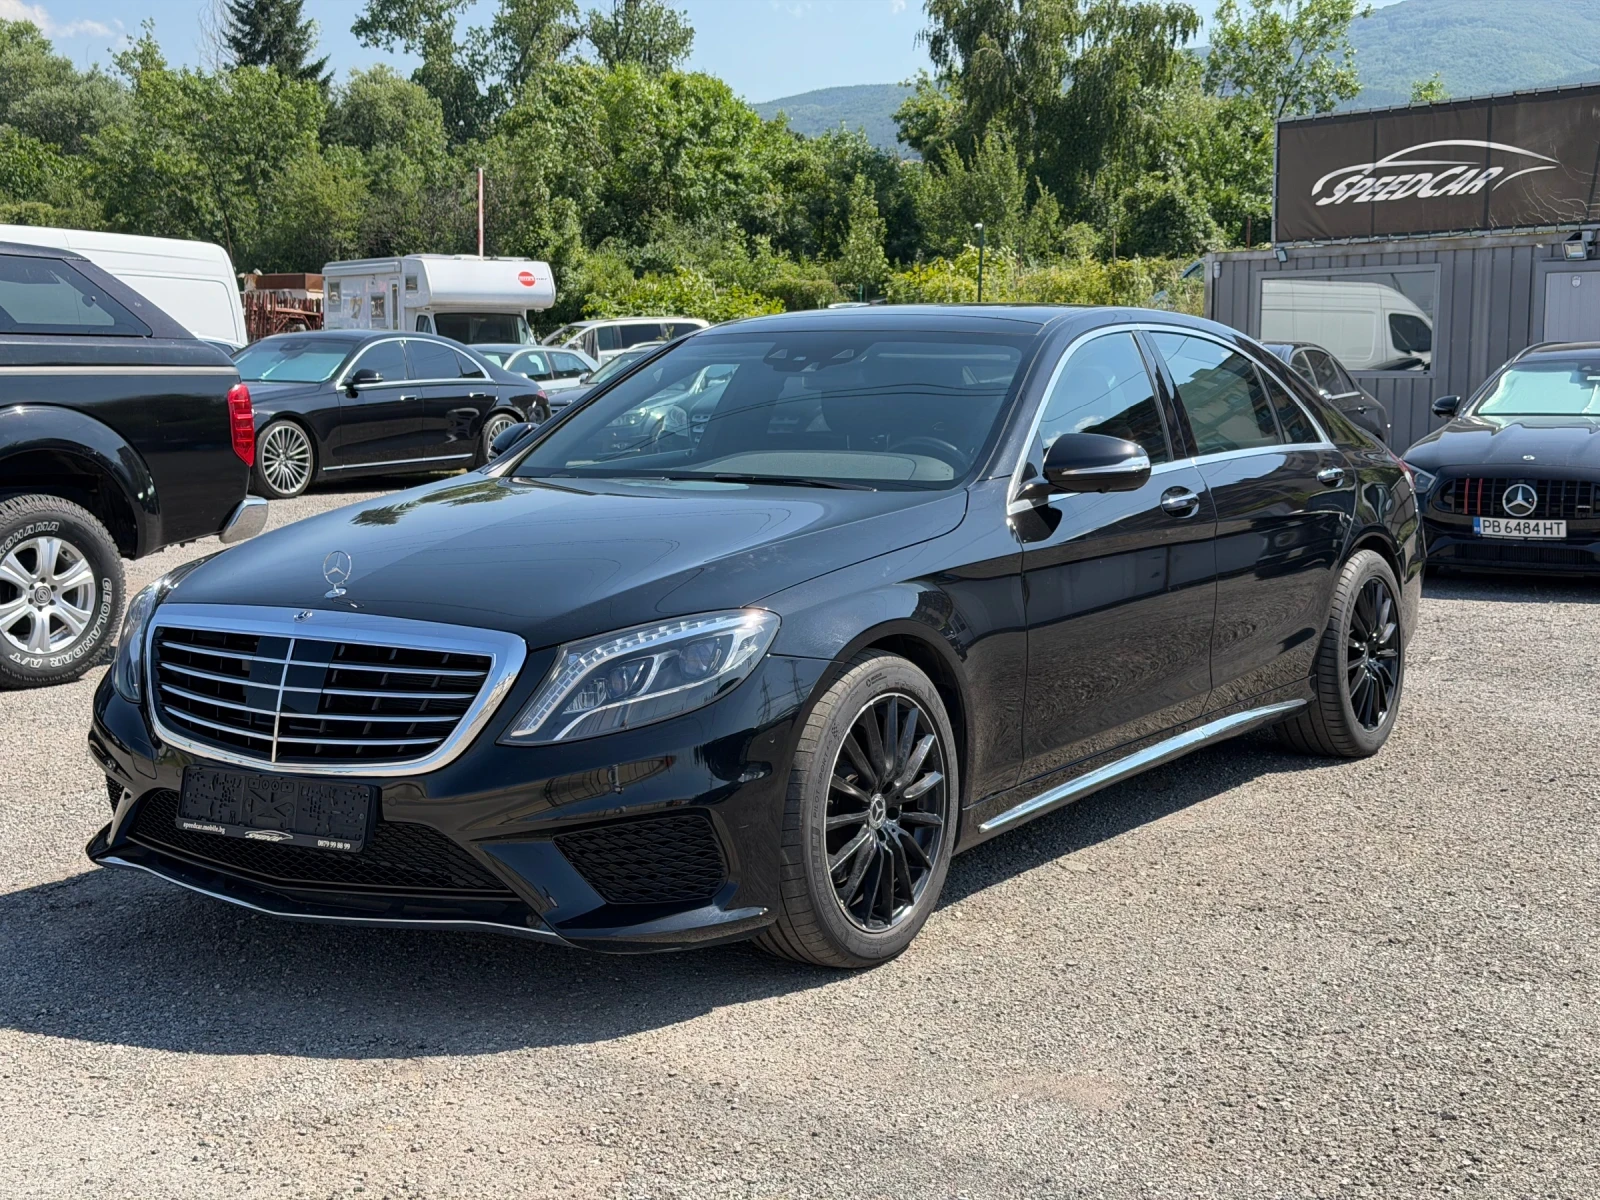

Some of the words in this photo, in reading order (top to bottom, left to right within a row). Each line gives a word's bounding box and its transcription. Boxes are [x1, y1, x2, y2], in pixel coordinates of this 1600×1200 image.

[1482, 519, 1501, 533] PB
[1504, 521, 1540, 535] 6484
[1543, 522, 1563, 535] HT
[50, 578, 112, 667] GEOLANDAR
[813, 790, 821, 819] PILOT
[817, 753, 830, 785] SPORT
